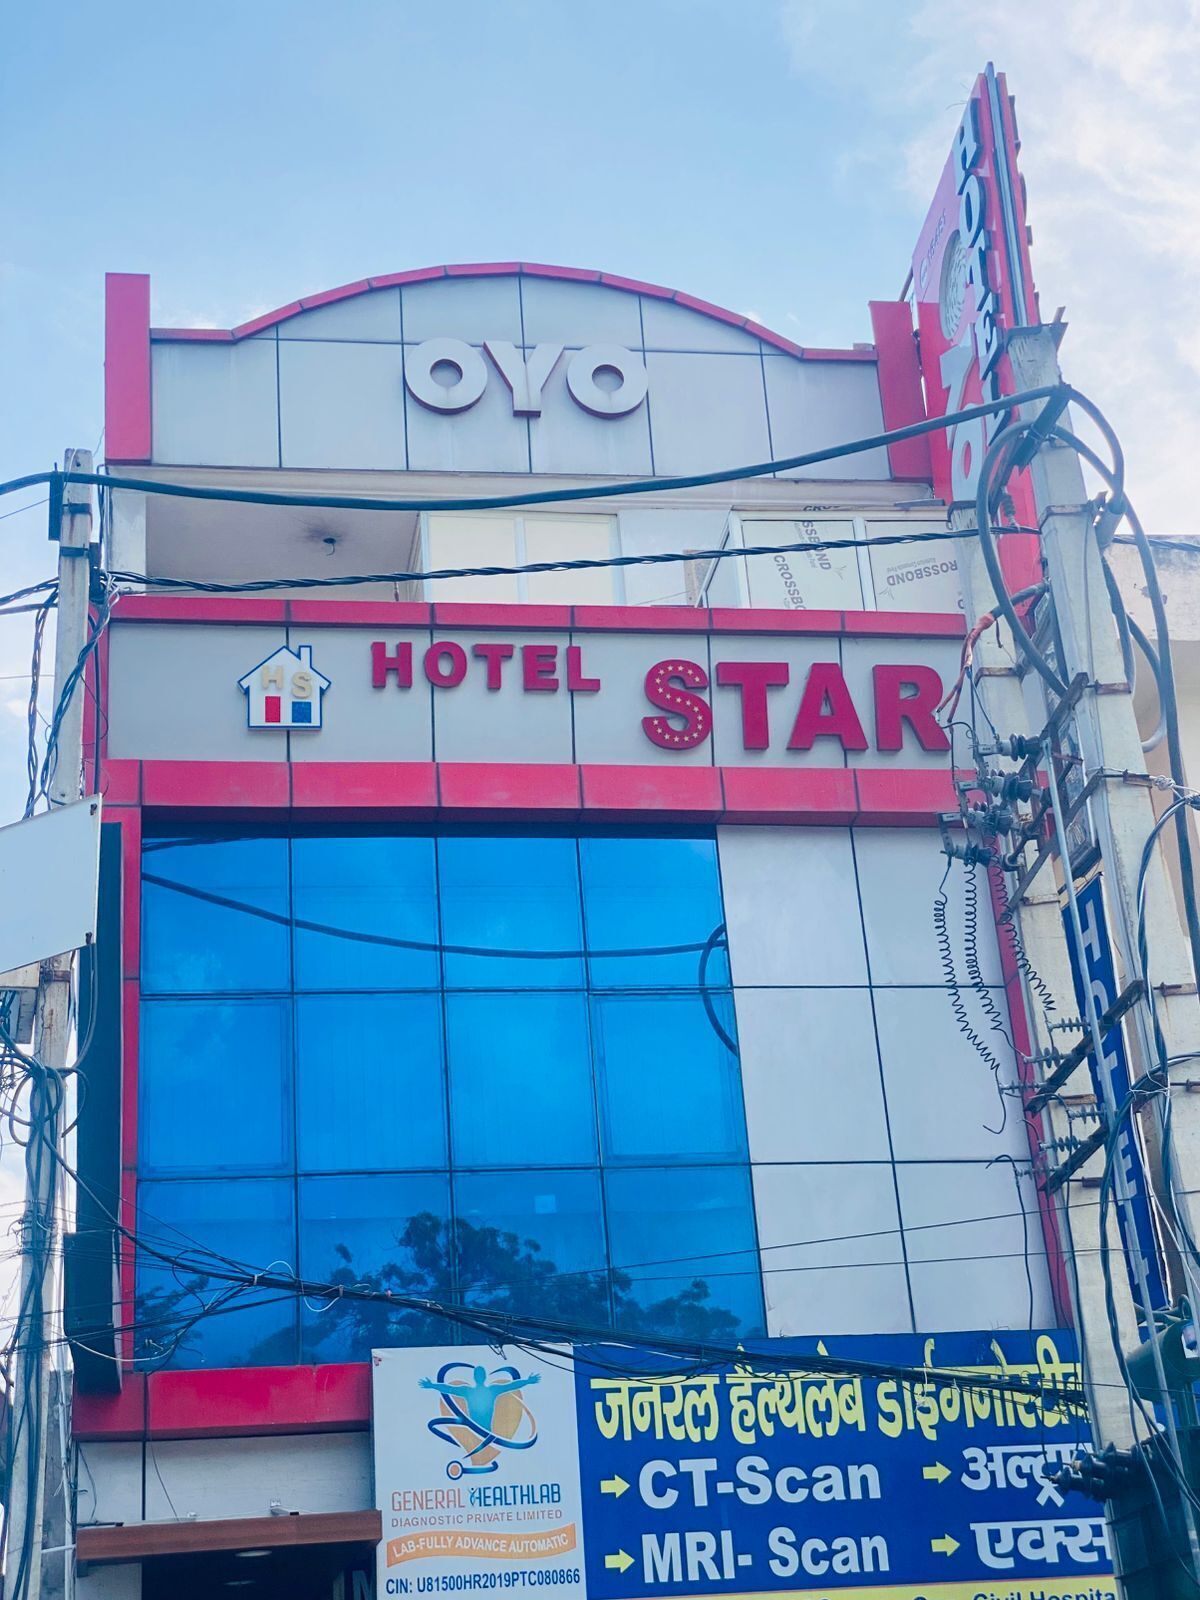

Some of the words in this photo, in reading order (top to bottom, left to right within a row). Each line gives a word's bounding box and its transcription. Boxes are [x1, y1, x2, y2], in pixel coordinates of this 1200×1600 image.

[404, 337, 648, 420] OYO
[371, 641, 600, 692] HOTEL
[641, 659, 951, 751] STAR
[590, 1373, 720, 1443] जनरल
[391, 1488, 466, 1512] GENERAL
[468, 1483, 561, 1507] HEALTHLAB
[638, 1455, 881, 1509] CT-Scan
[391, 1514, 464, 1528] DIAGNOSTIC
[466, 1511, 513, 1524] PRIVATE
[516, 1509, 563, 1521] LIMITED
[393, 1536, 453, 1557] LAB-FULLY
[455, 1536, 507, 1553] ADVANCE
[508, 1533, 569, 1553] AUTOMATIC
[386, 1577, 413, 1595] CIN:
[417, 1568, 580, 1593] U81500HR2019PTC080866
[641, 1529, 752, 1584] MRI-
[768, 1526, 889, 1577] Scan
